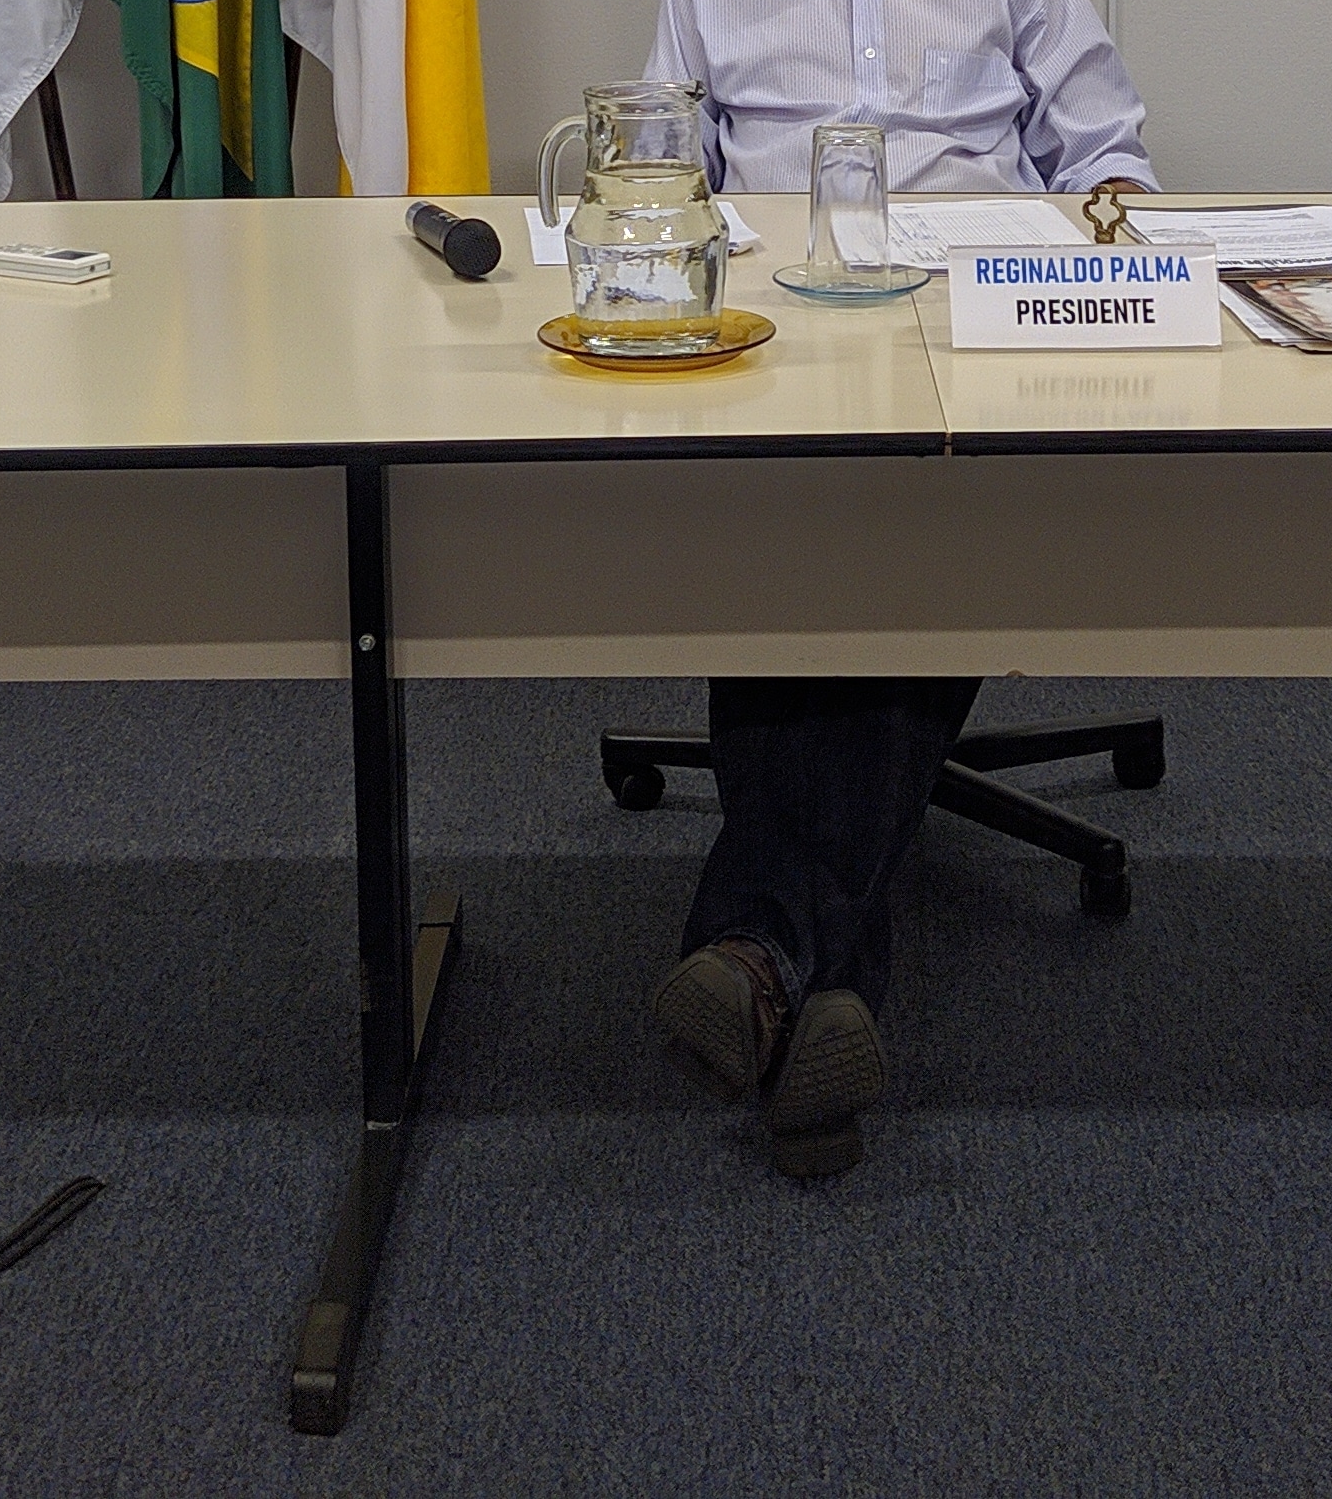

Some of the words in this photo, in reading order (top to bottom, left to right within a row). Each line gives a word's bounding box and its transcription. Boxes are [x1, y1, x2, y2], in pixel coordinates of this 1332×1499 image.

[976, 257, 1104, 284] REGINALDO
[1110, 256, 1191, 282] PALMA
[1016, 298, 1156, 325] PRESIDENTE
